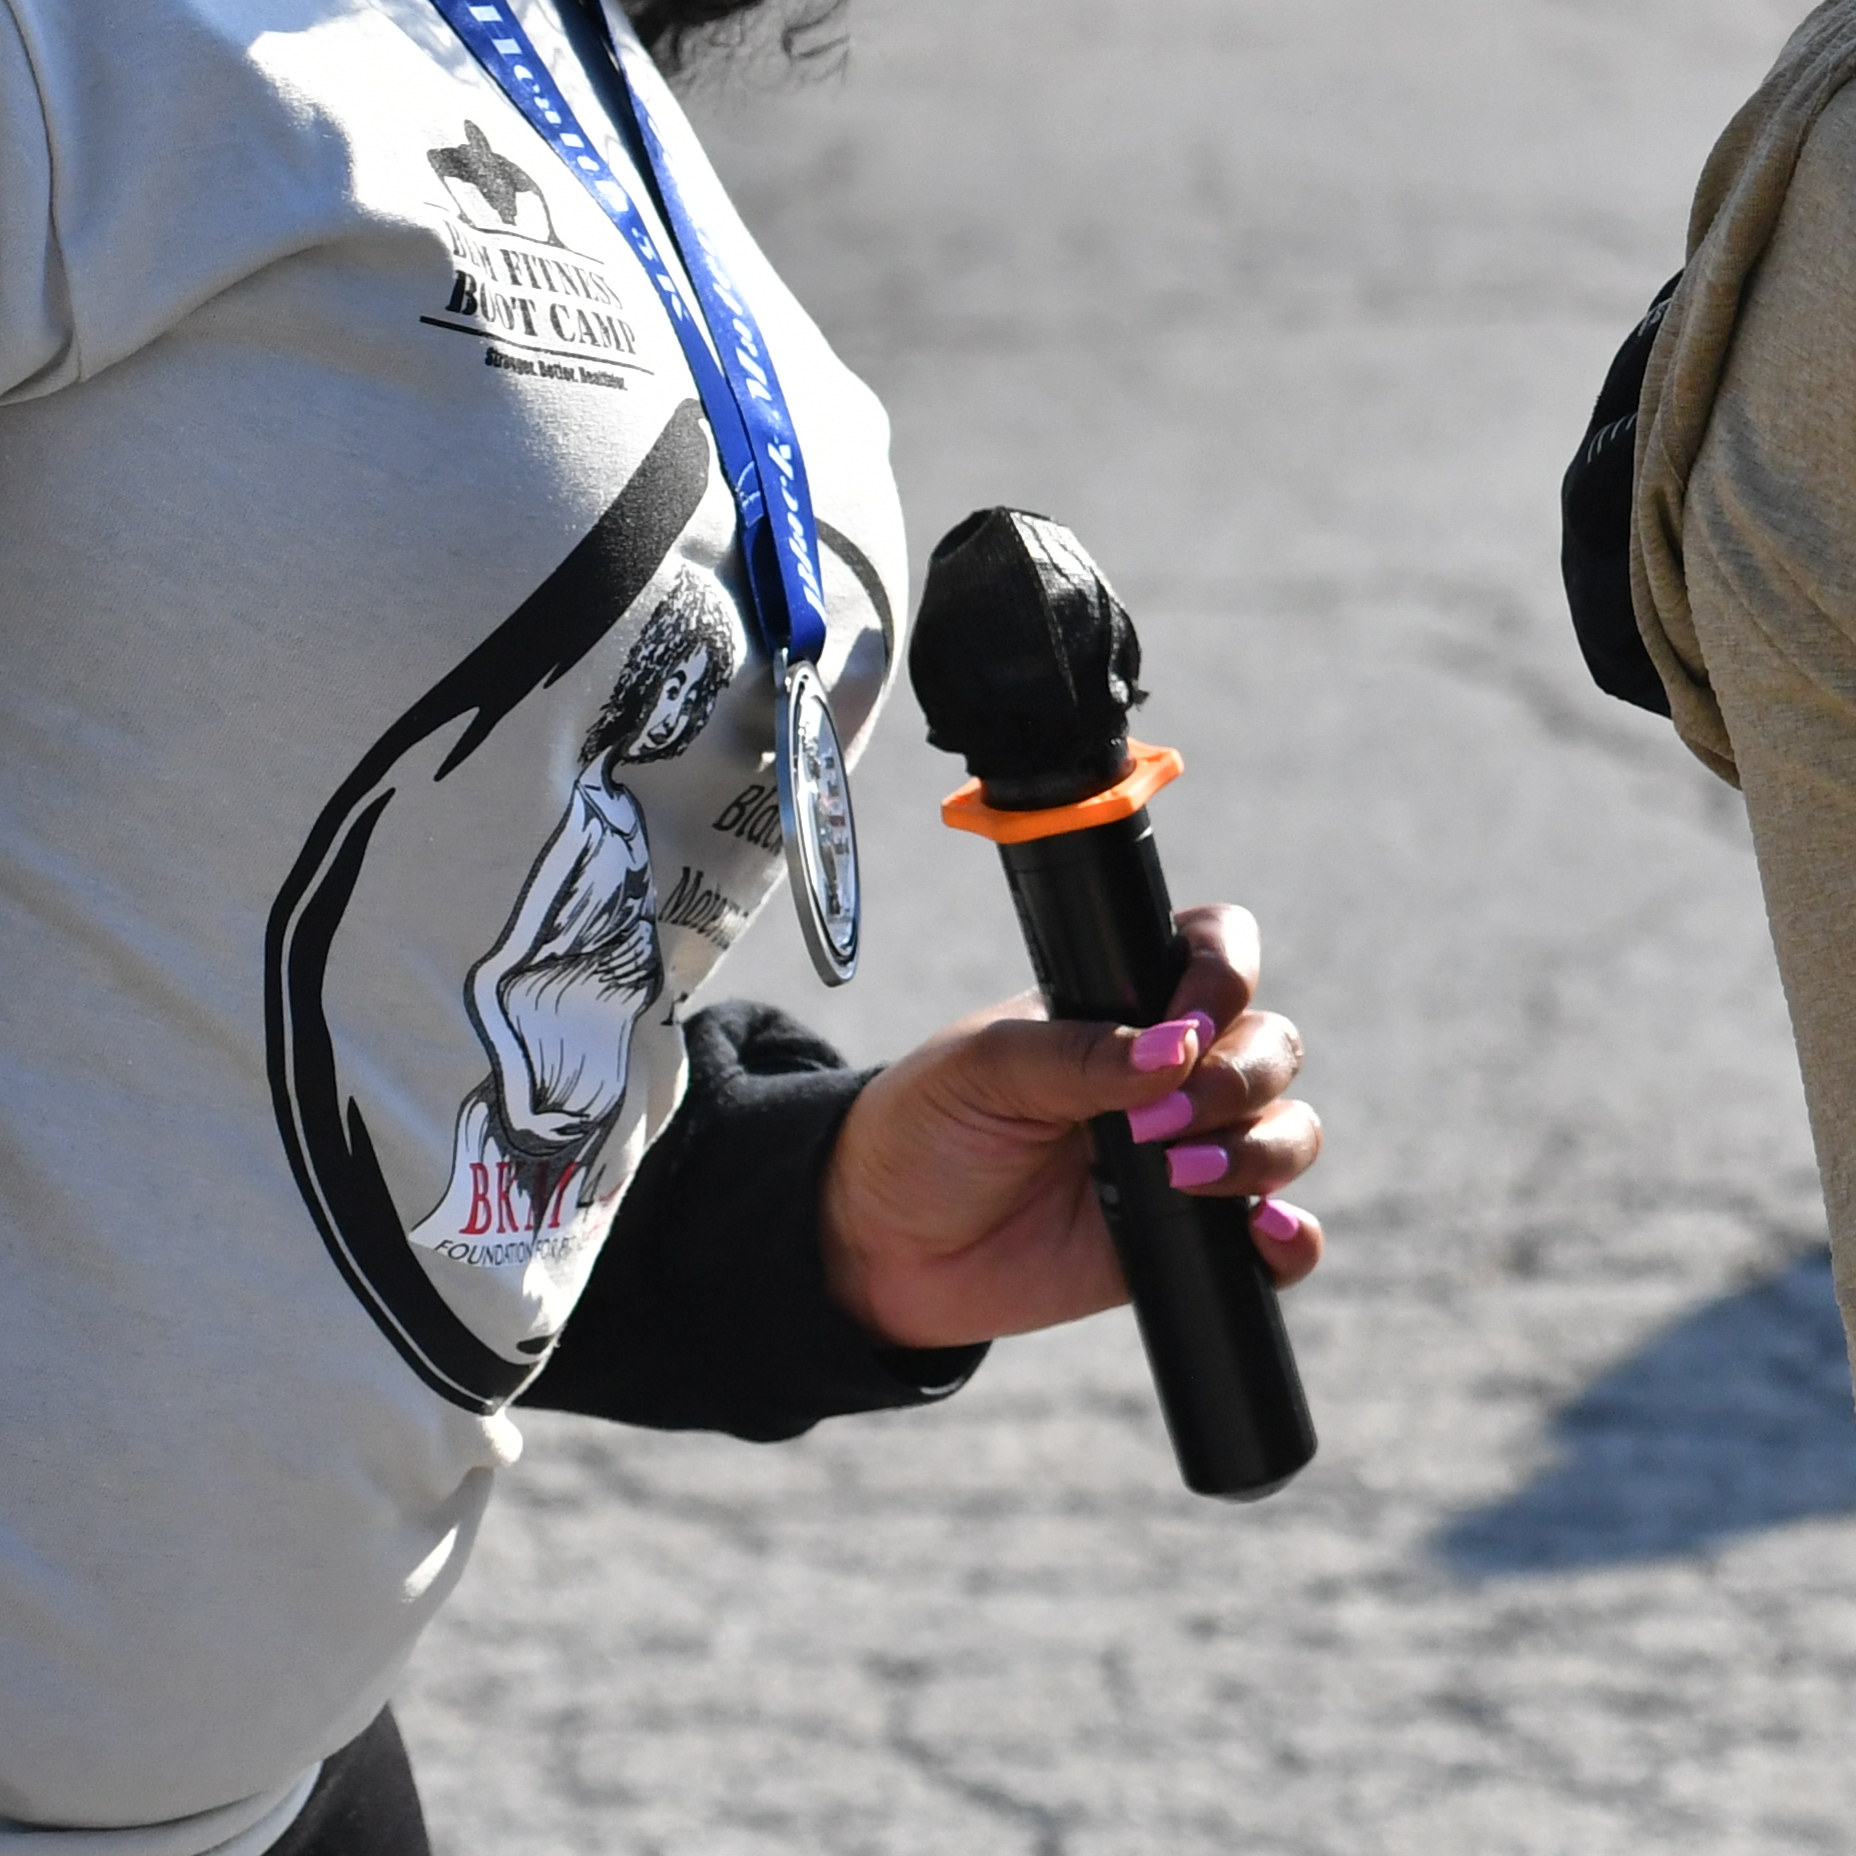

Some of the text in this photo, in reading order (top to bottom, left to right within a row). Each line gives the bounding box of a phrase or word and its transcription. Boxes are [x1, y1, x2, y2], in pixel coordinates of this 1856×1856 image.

[499, 247, 623, 310] FITNESS
[444, 269, 637, 355] BOOT CAMP
[434, 1239, 534, 1267] FOUNDATION
